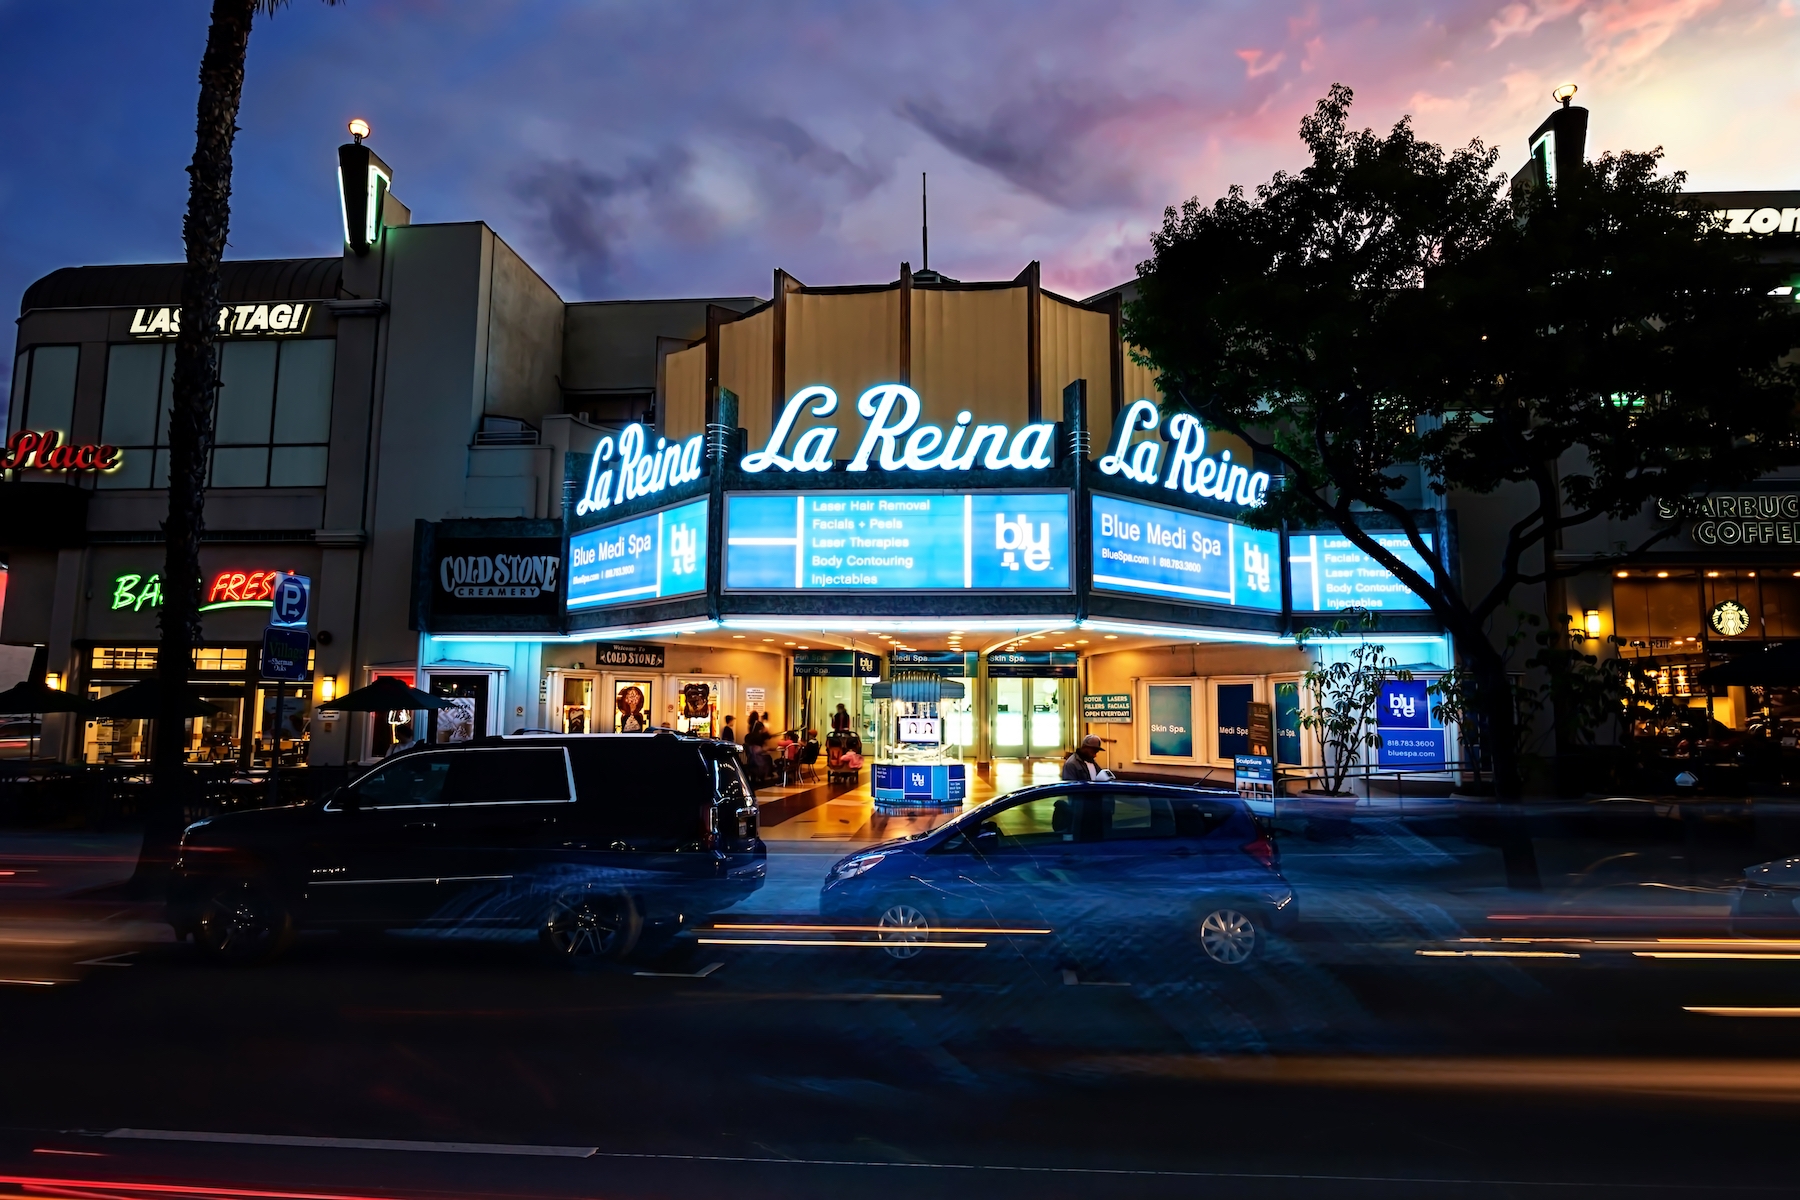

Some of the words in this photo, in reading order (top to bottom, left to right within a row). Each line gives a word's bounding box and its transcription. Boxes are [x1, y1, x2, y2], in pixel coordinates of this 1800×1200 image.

[130, 306, 229, 333] LASR
[235, 304, 304, 330] TAG!
[740, 385, 838, 473] La
[846, 383, 1055, 472] Reina
[1, 429, 115, 469] Place
[1099, 399, 1160, 485] La
[1164, 413, 1270, 508] Reina
[576, 436, 613, 516] La
[614, 423, 703, 505] Reina
[813, 500, 846, 511] Laser
[850, 500, 874, 511] Hair
[879, 499, 930, 511] Removal
[813, 519, 854, 529] Facials
[870, 518, 903, 529] Peels
[1101, 514, 1141, 541] Blue
[1147, 522, 1186, 550] Medi
[1192, 531, 1221, 559] Spa
[812, 537, 845, 548] Laser
[850, 537, 909, 549] Therapies
[573, 546, 595, 567] Blue
[598, 536, 625, 561] Medi
[628, 534, 651, 559] Spa
[1102, 548, 1149, 565] BlueSpa.com
[812, 556, 843, 568] Body
[847, 556, 913, 568] Contouring
[1325, 553, 1360, 563] Facials
[440, 556, 494, 592] COLD
[494, 554, 560, 592] STONE
[1326, 569, 1353, 578] Laser
[1357, 568, 1396, 579] Therap
[210, 571, 277, 601] FRES
[812, 574, 878, 587] Injectables
[457, 588, 537, 596] CREAMERY
[1326, 583, 1352, 594] Body
[1356, 583, 1412, 594] Contouring
[1327, 598, 1383, 609] Injectables
[606, 650, 627, 664] COLD
[628, 652, 656, 665] STONE
[989, 654, 1006, 662] Skin
[795, 666, 811, 674] Your
[1151, 724, 1167, 732] Skin
[1219, 726, 1235, 735] Medi
[1388, 750, 1435, 758] bluespa.com
